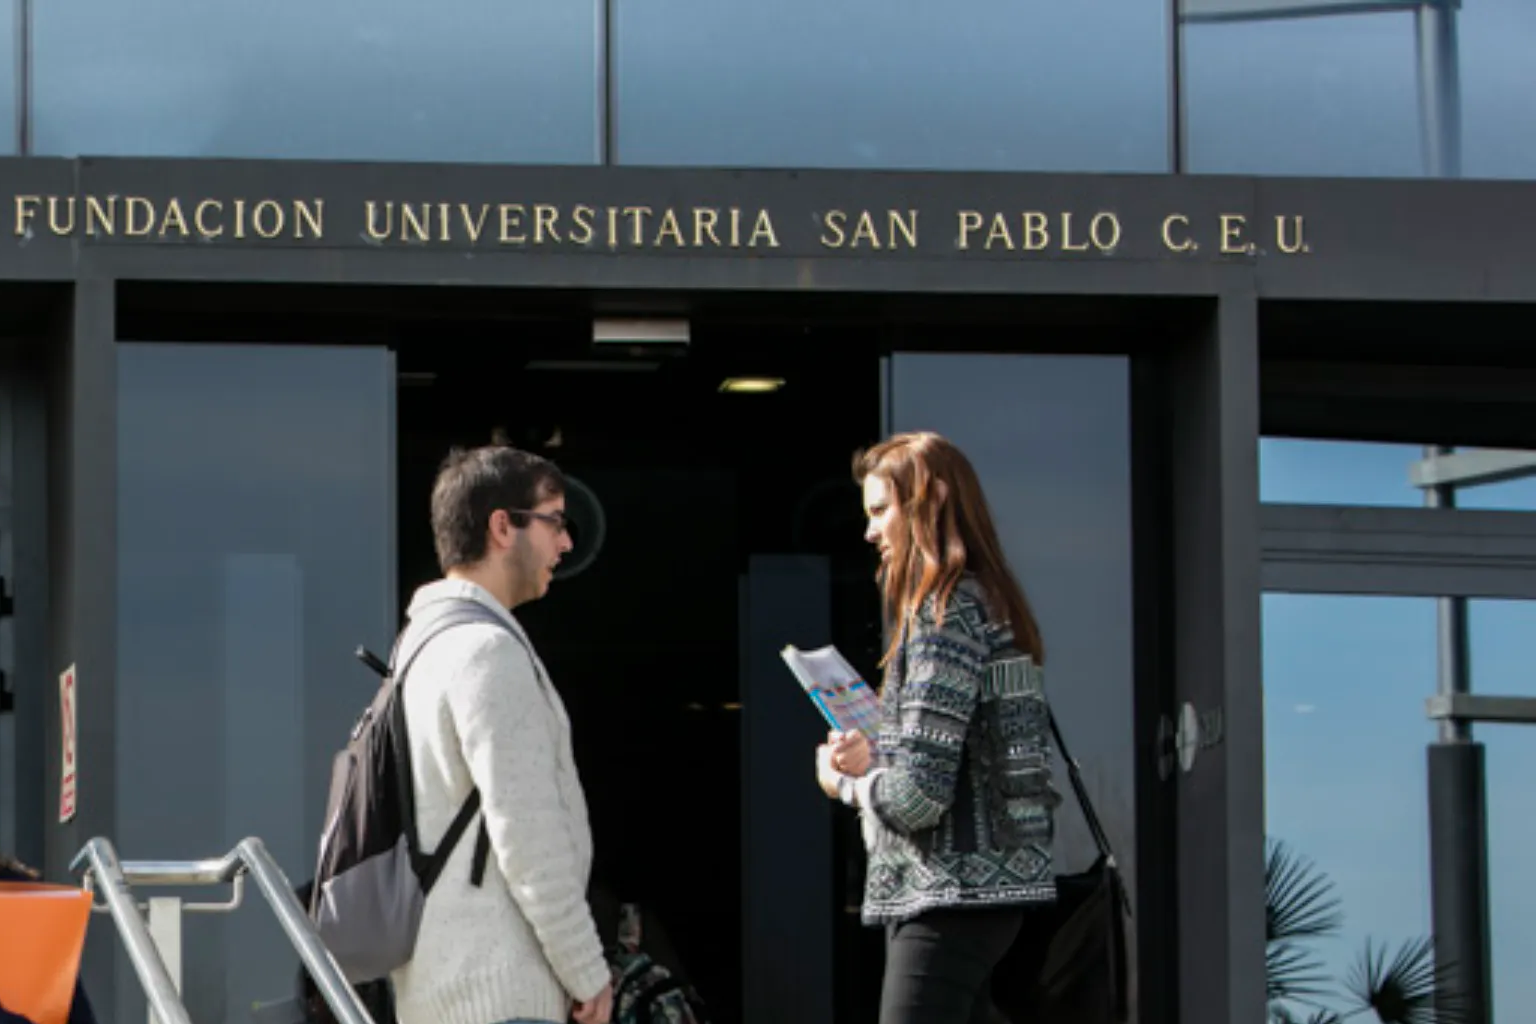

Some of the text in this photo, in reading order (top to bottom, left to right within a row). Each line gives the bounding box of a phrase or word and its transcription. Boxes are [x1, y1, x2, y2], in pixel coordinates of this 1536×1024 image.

[14, 195, 324, 238] FUNDACION
[365, 201, 780, 247] UNIVERSITARIA
[820, 209, 921, 249] SAN
[957, 210, 1121, 251] PABLO
